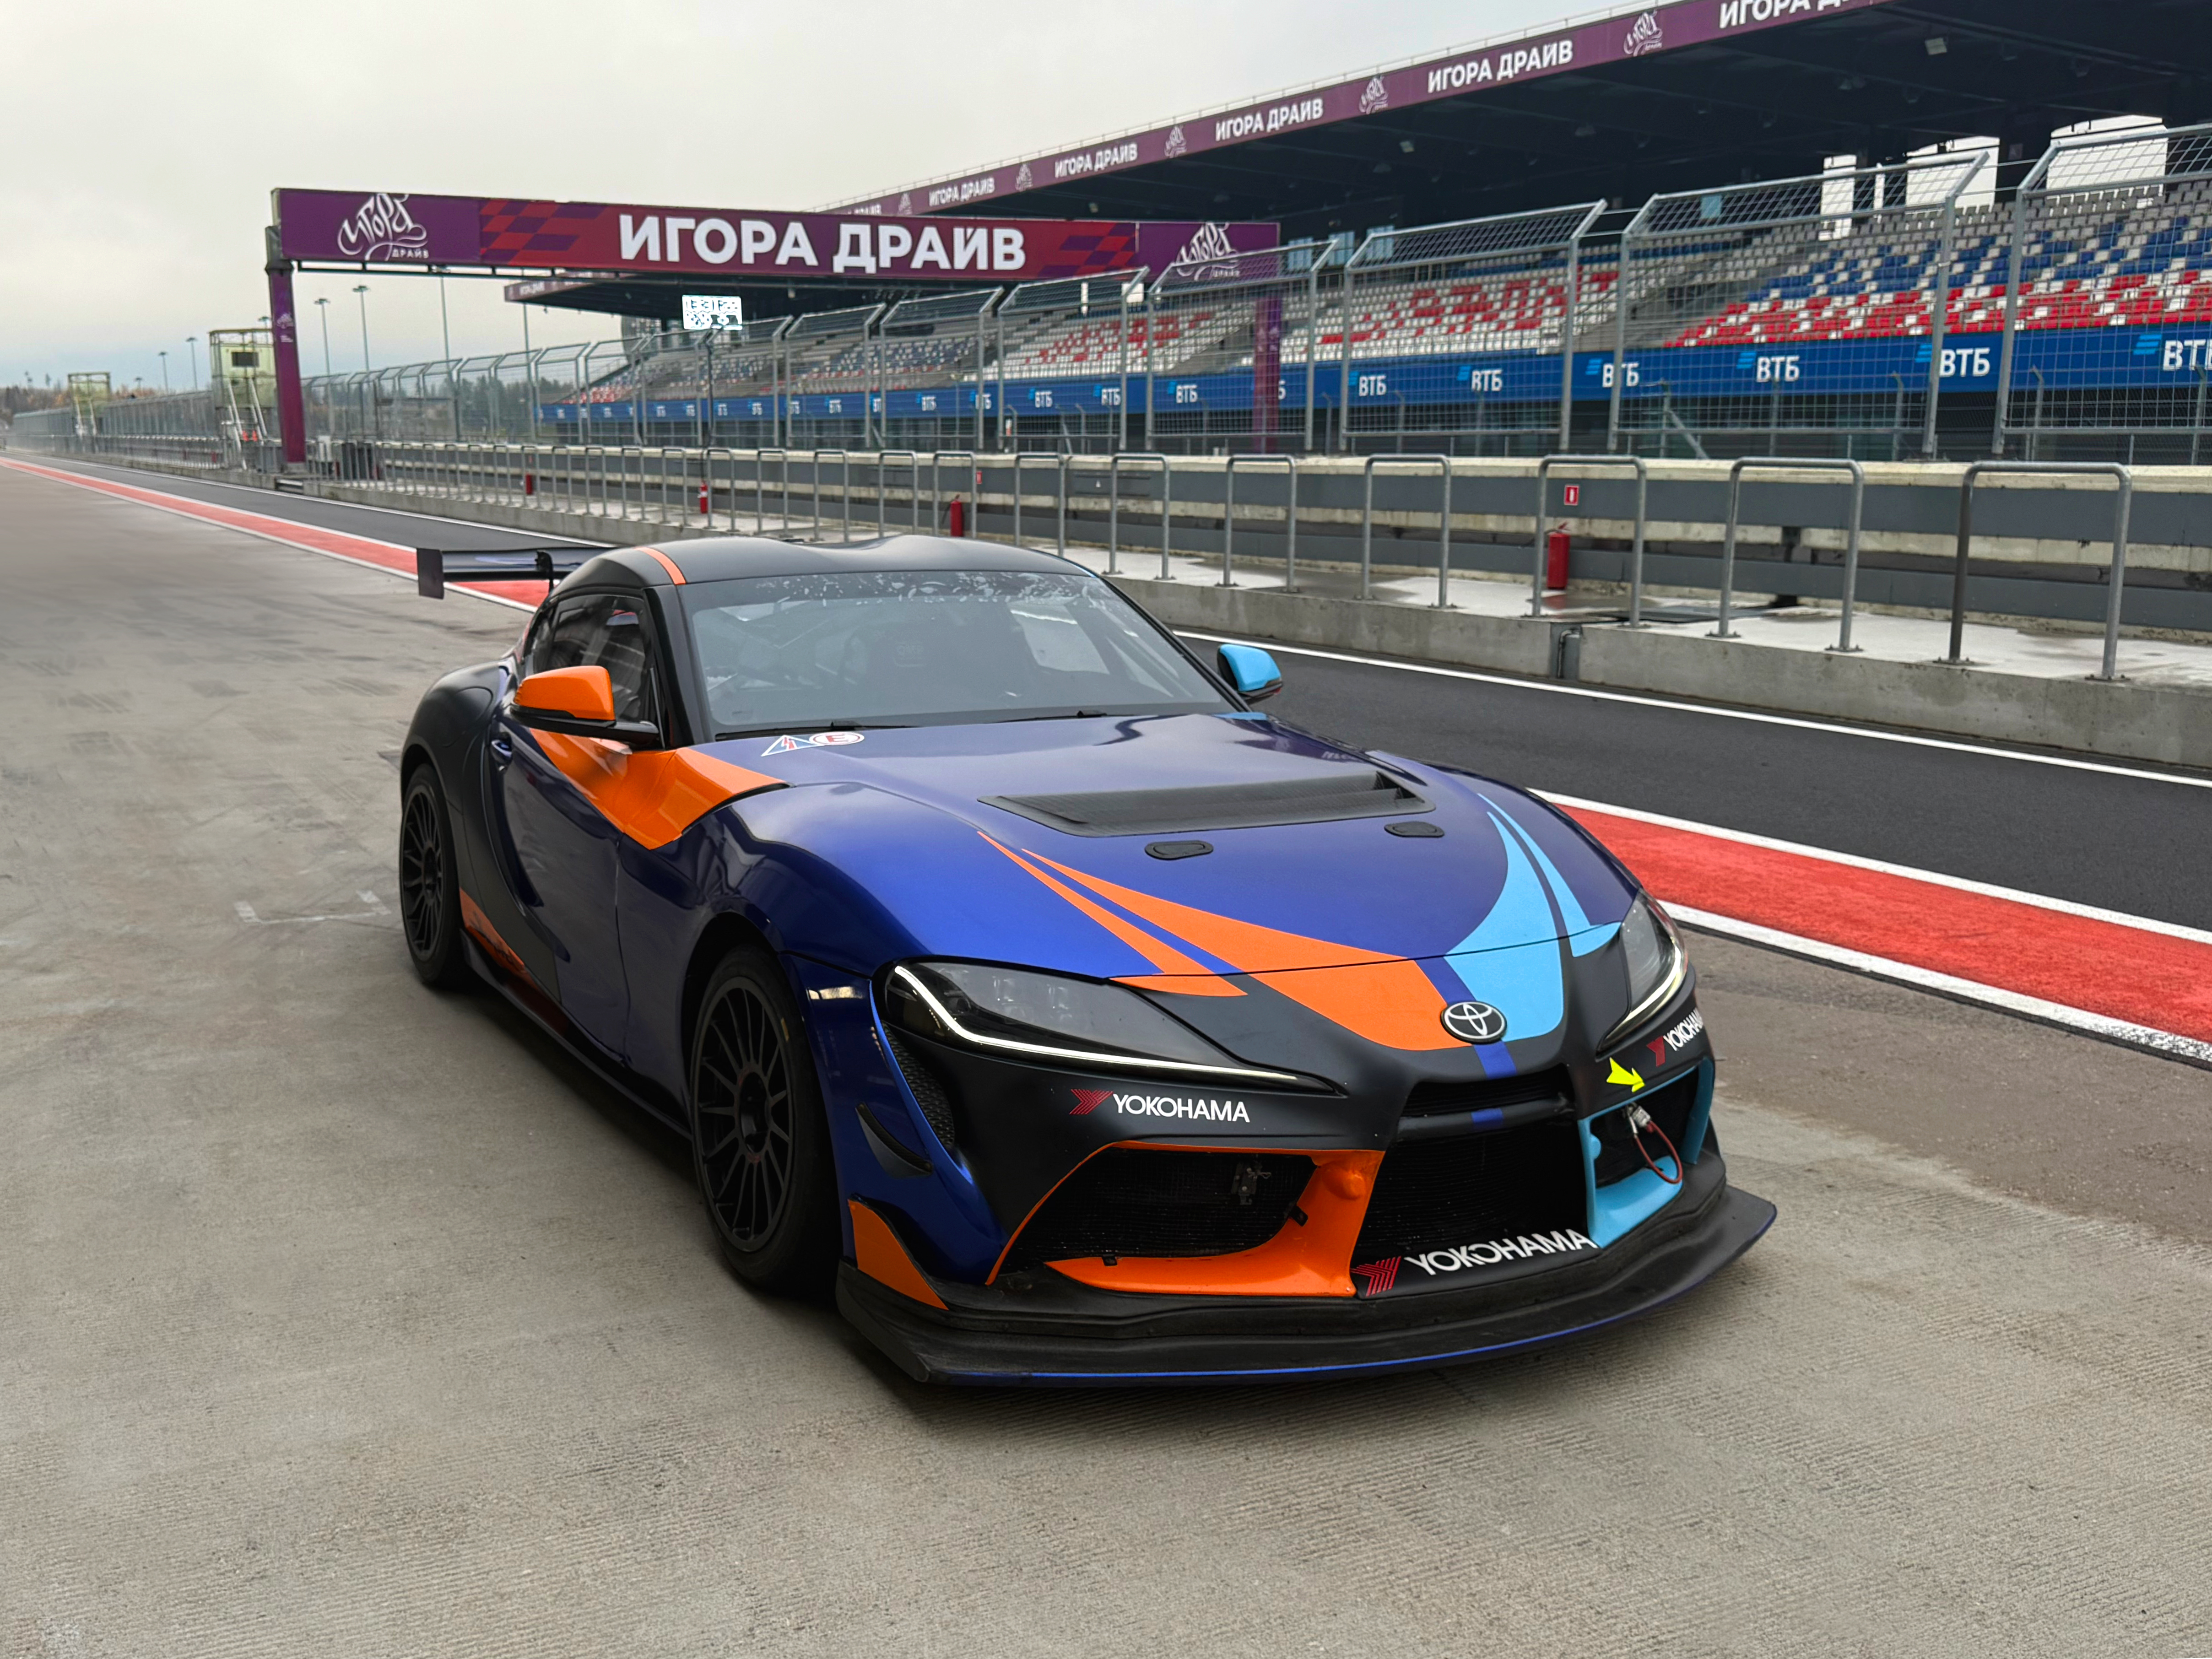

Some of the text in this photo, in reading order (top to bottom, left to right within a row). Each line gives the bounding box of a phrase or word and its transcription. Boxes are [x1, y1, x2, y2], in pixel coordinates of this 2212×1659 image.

[1428, 40, 1573, 93] ИГОРА ДРАЙВ
[1216, 97, 1324, 141] ИГОРА ДРАЙВ
[1055, 151, 1093, 178] ИГОРА
[1094, 142, 1138, 172] ДРАЙВ
[619, 214, 1026, 274] ИГОРА ДРАЙВ
[1602, 362, 1639, 387] ВБ
[1756, 355, 1800, 382] ВТБ
[1939, 347, 1990, 377] ВТБ
[1176, 384, 1198, 403] ВТБ
[1359, 374, 1387, 396] ВТБ
[1471, 369, 1503, 392] ВТБ
[1113, 1093, 1250, 1123] YOKOHAMA
[1404, 1229, 1598, 1275] YOKOHAMA
